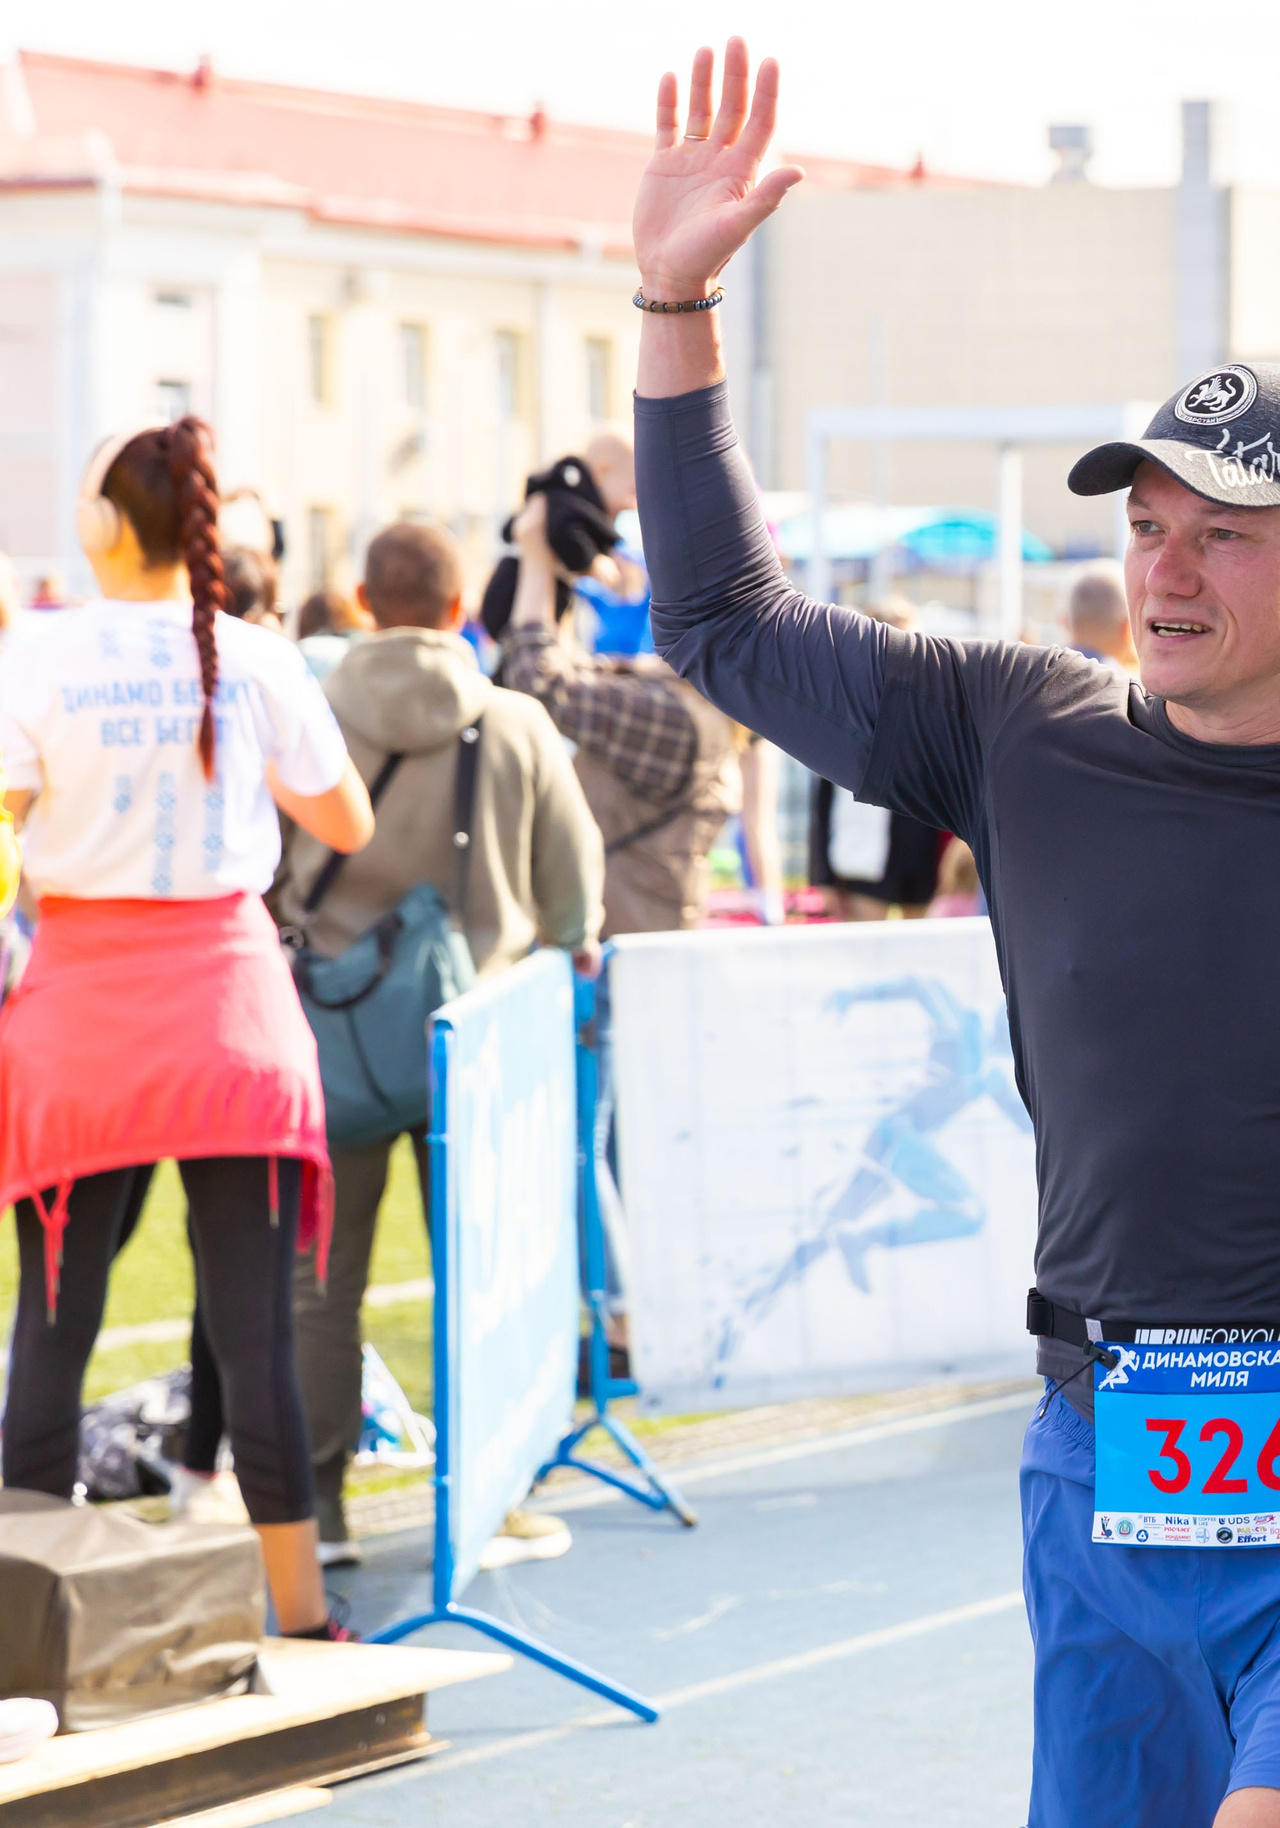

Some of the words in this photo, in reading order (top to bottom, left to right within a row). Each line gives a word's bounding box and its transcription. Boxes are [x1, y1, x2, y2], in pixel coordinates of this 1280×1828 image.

[62, 679, 163, 713] ДИНАМО
[101, 717, 144, 746] ВСЕ
[1190, 1371, 1249, 1388] МИЛЯ
[1165, 1516, 1190, 1526] Nika
[1227, 1517, 1251, 1525] UDS
[1236, 1534, 1267, 1544] Effort
